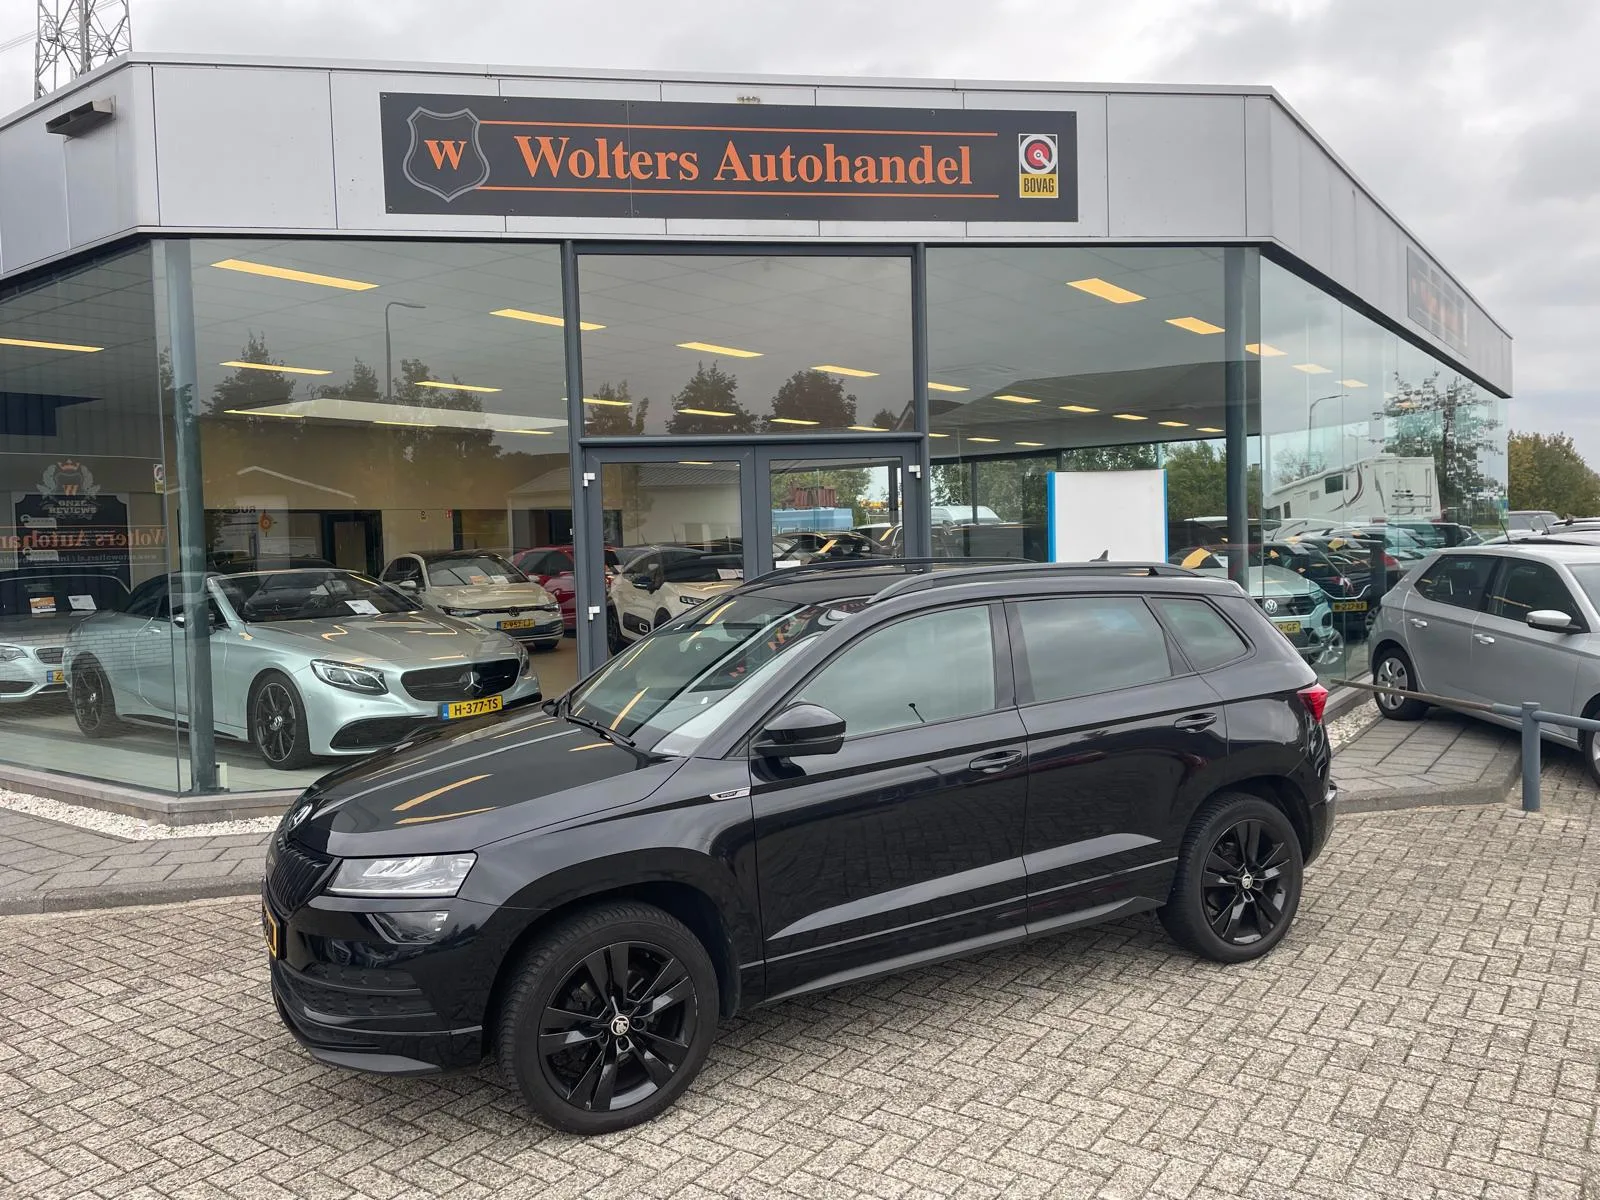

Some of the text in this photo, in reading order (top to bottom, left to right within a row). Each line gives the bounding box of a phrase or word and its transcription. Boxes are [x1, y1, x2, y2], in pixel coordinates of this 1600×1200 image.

[426, 139, 465, 169] W
[515, 135, 972, 186] Wolters Autohandel
[1023, 177, 1055, 193] BOVAG
[454, 698, 498, 715] H-377-TS
